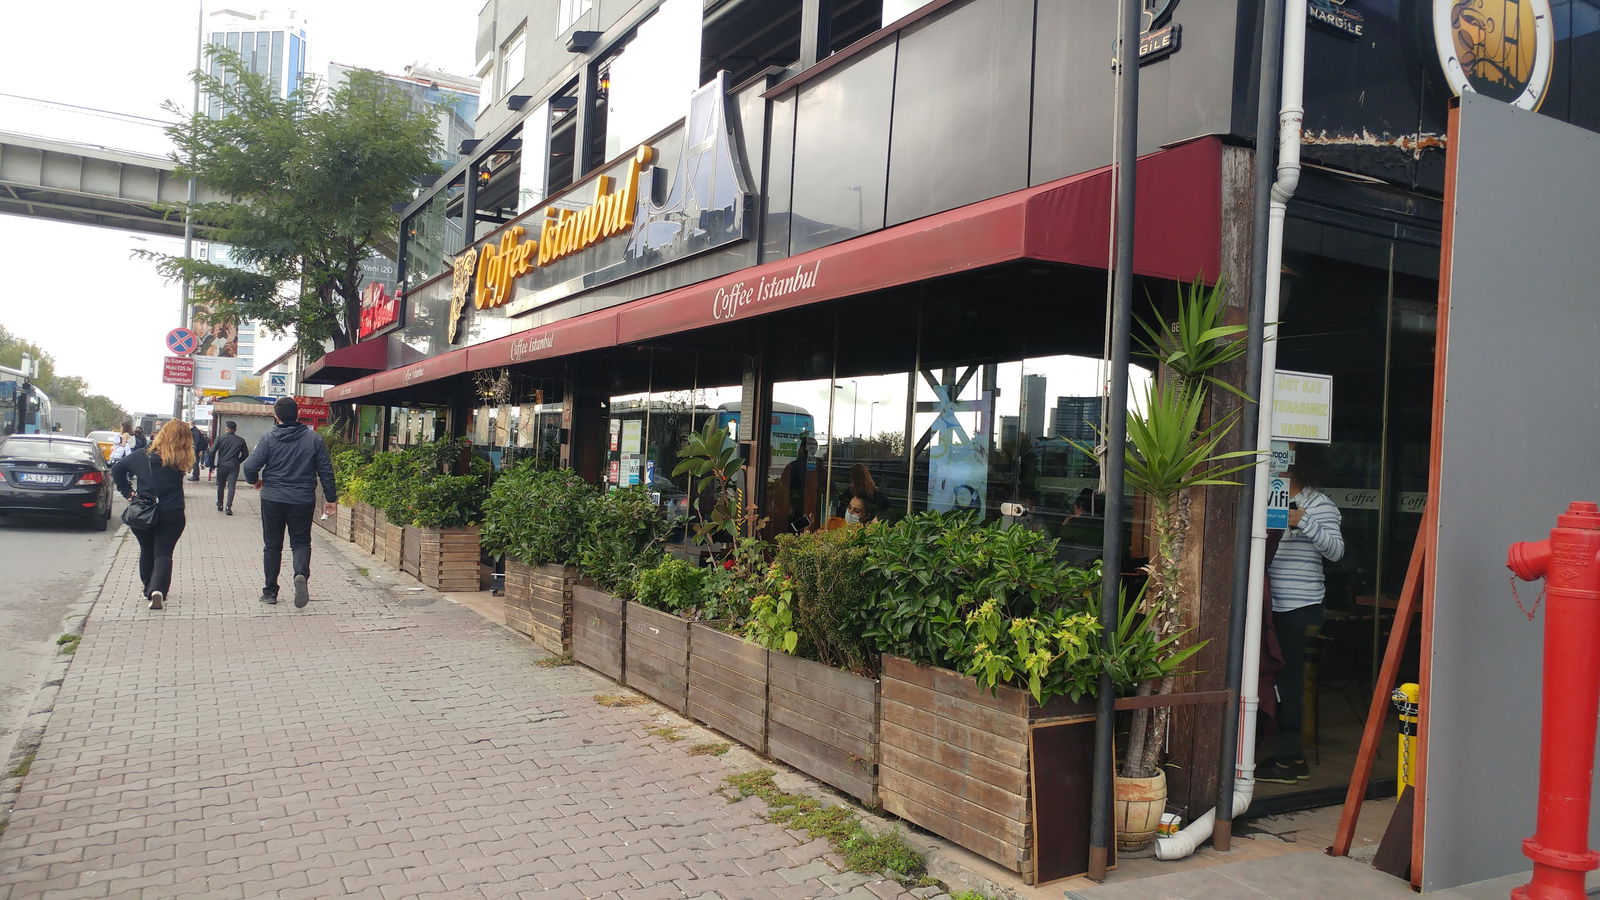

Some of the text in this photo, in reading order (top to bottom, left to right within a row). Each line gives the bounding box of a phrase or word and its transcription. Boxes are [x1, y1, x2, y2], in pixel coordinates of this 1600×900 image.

[474, 225, 538, 310] Coffee
[537, 147, 652, 267] istanbul
[363, 264, 393, 274] Yeni i20
[713, 260, 821, 319] Coffee istanbul
[511, 330, 554, 361] Coffee istanbul
[1345, 492, 1376, 505] Coffee
